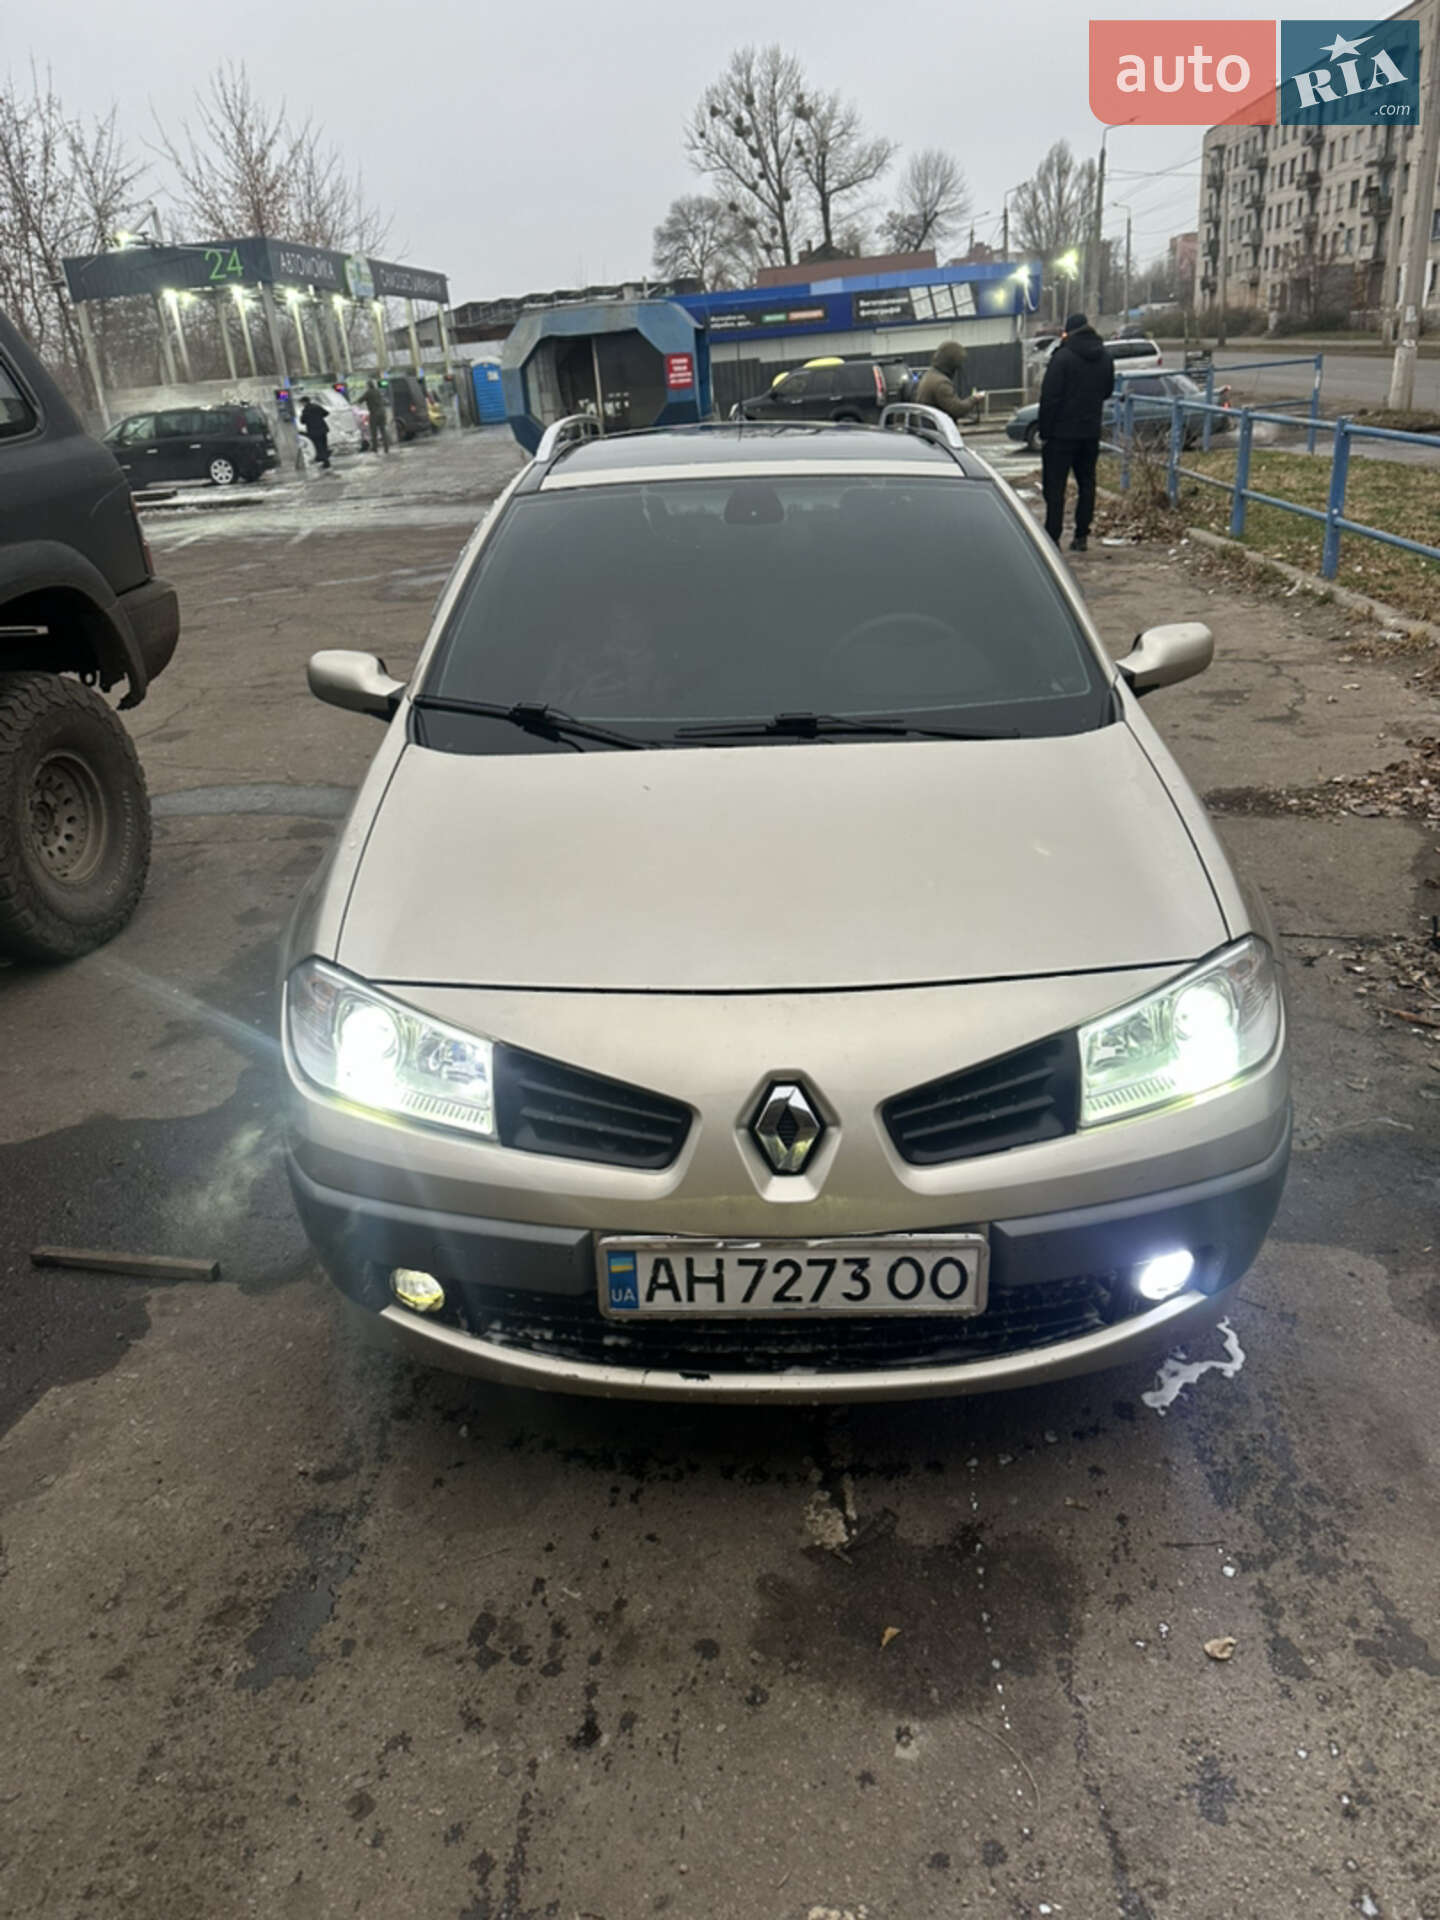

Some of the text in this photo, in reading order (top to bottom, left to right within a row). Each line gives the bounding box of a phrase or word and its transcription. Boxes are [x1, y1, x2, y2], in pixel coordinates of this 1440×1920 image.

[205, 247, 244, 279] 24
[611, 1289, 636, 1304] UA
[645, 1257, 725, 1303] AH
[737, 1258, 871, 1303] 7273
